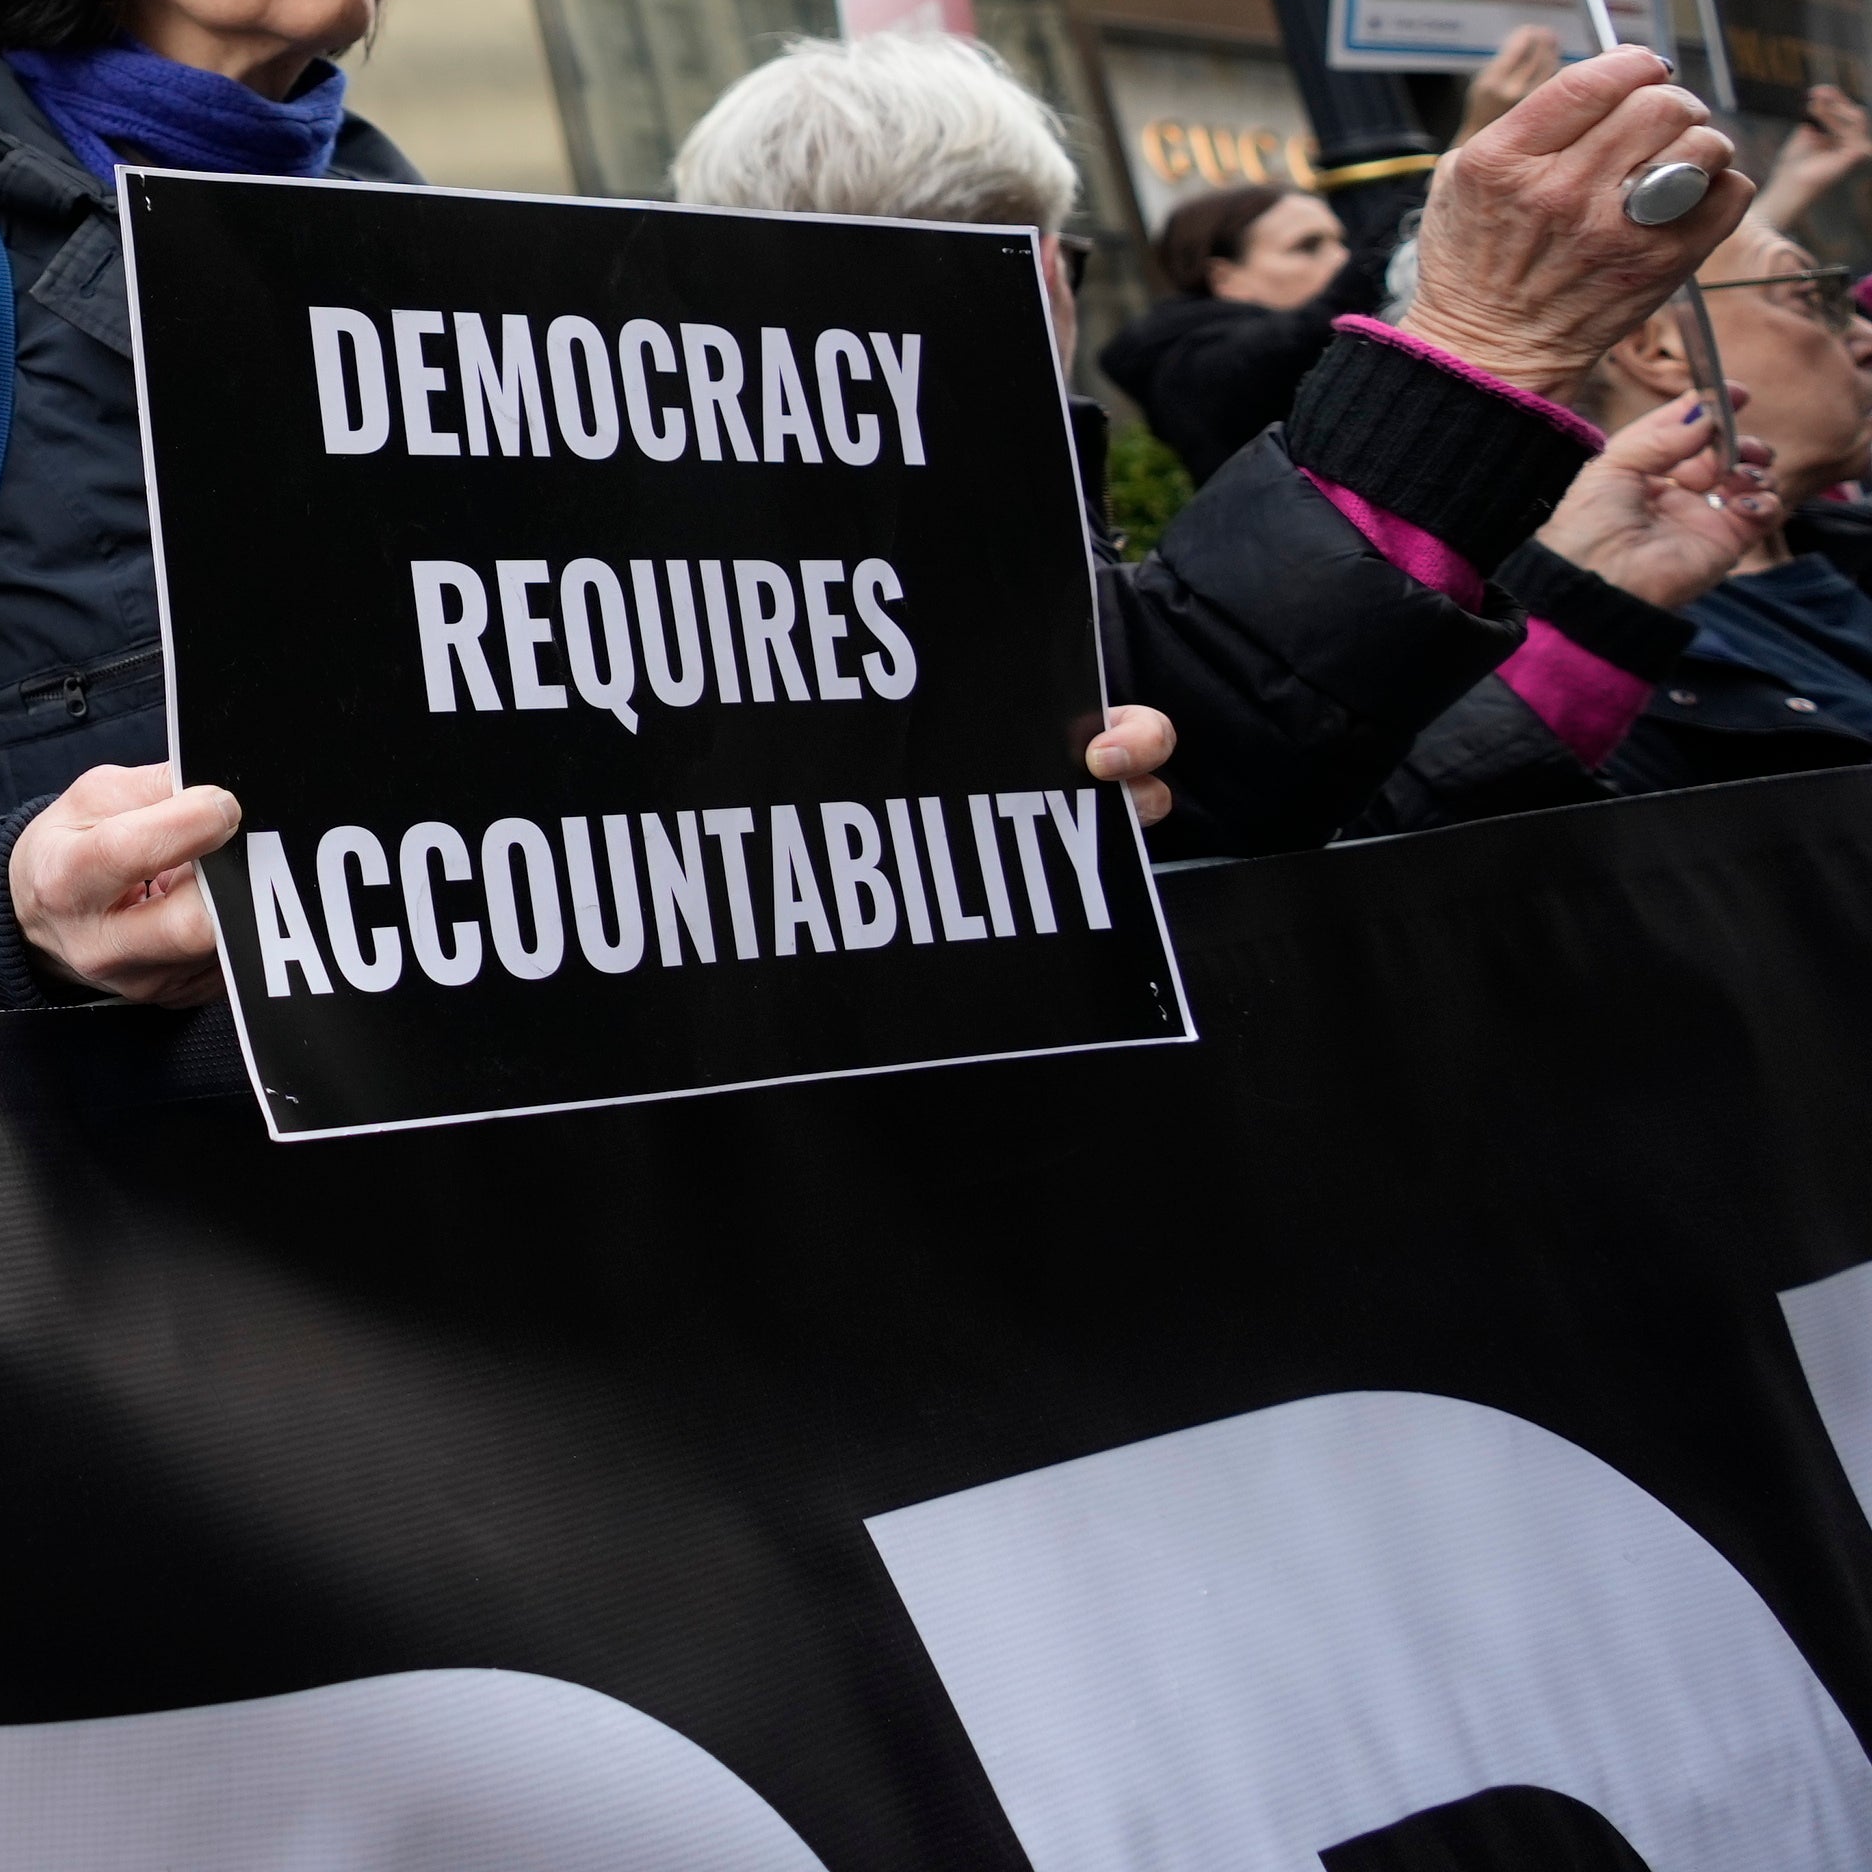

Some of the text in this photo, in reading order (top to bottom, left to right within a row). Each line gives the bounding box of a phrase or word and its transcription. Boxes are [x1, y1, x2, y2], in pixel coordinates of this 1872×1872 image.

[307, 304, 929, 467] DEMOCRACY
[409, 557, 918, 735] REQUIRES
[245, 787, 1114, 1000] ACCOUNTABILITY
